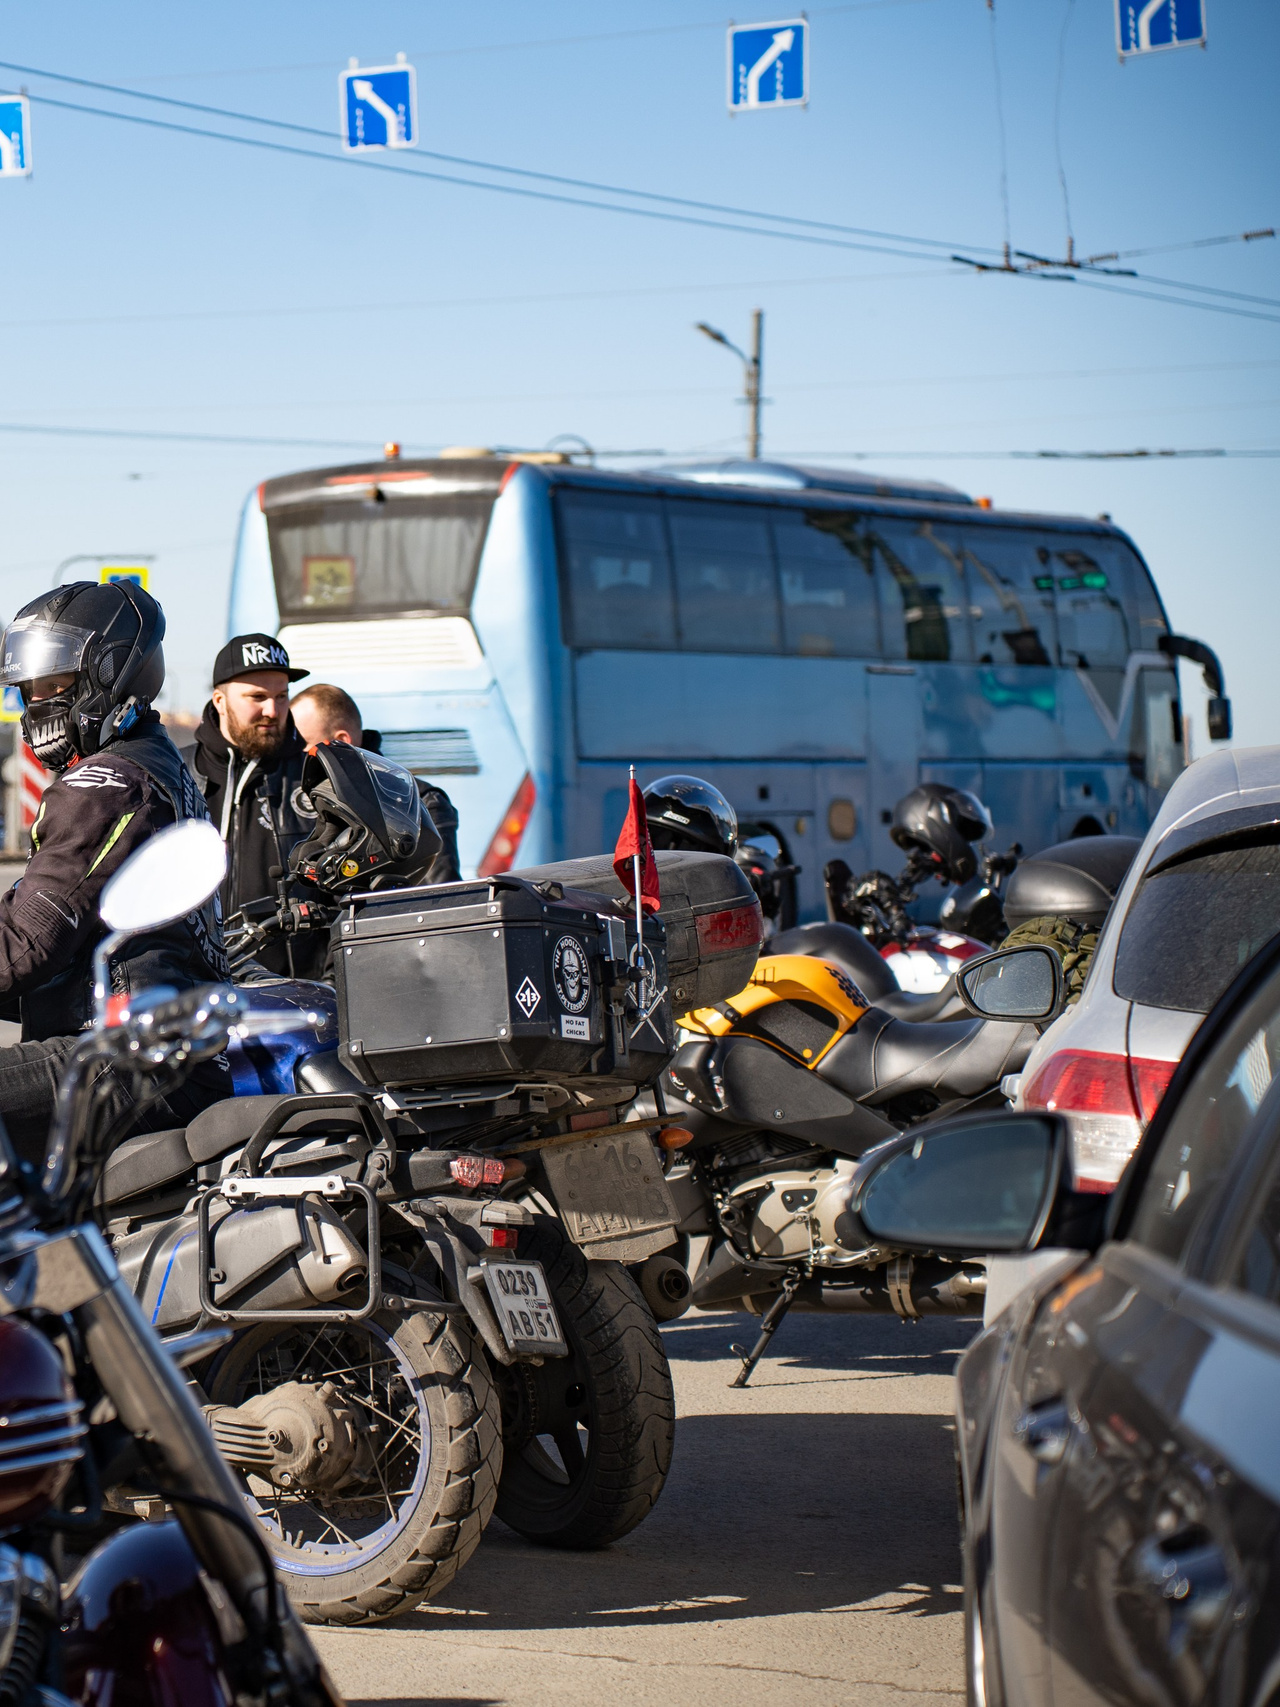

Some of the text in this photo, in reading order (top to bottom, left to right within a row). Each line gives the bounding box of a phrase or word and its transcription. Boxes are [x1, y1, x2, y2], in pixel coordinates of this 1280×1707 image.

[565, 1029, 586, 1037] CHICKS
[496, 1269, 538, 1297] 0239
[524, 1298, 539, 1309] RUS
[508, 1310, 558, 1339] AB 51
